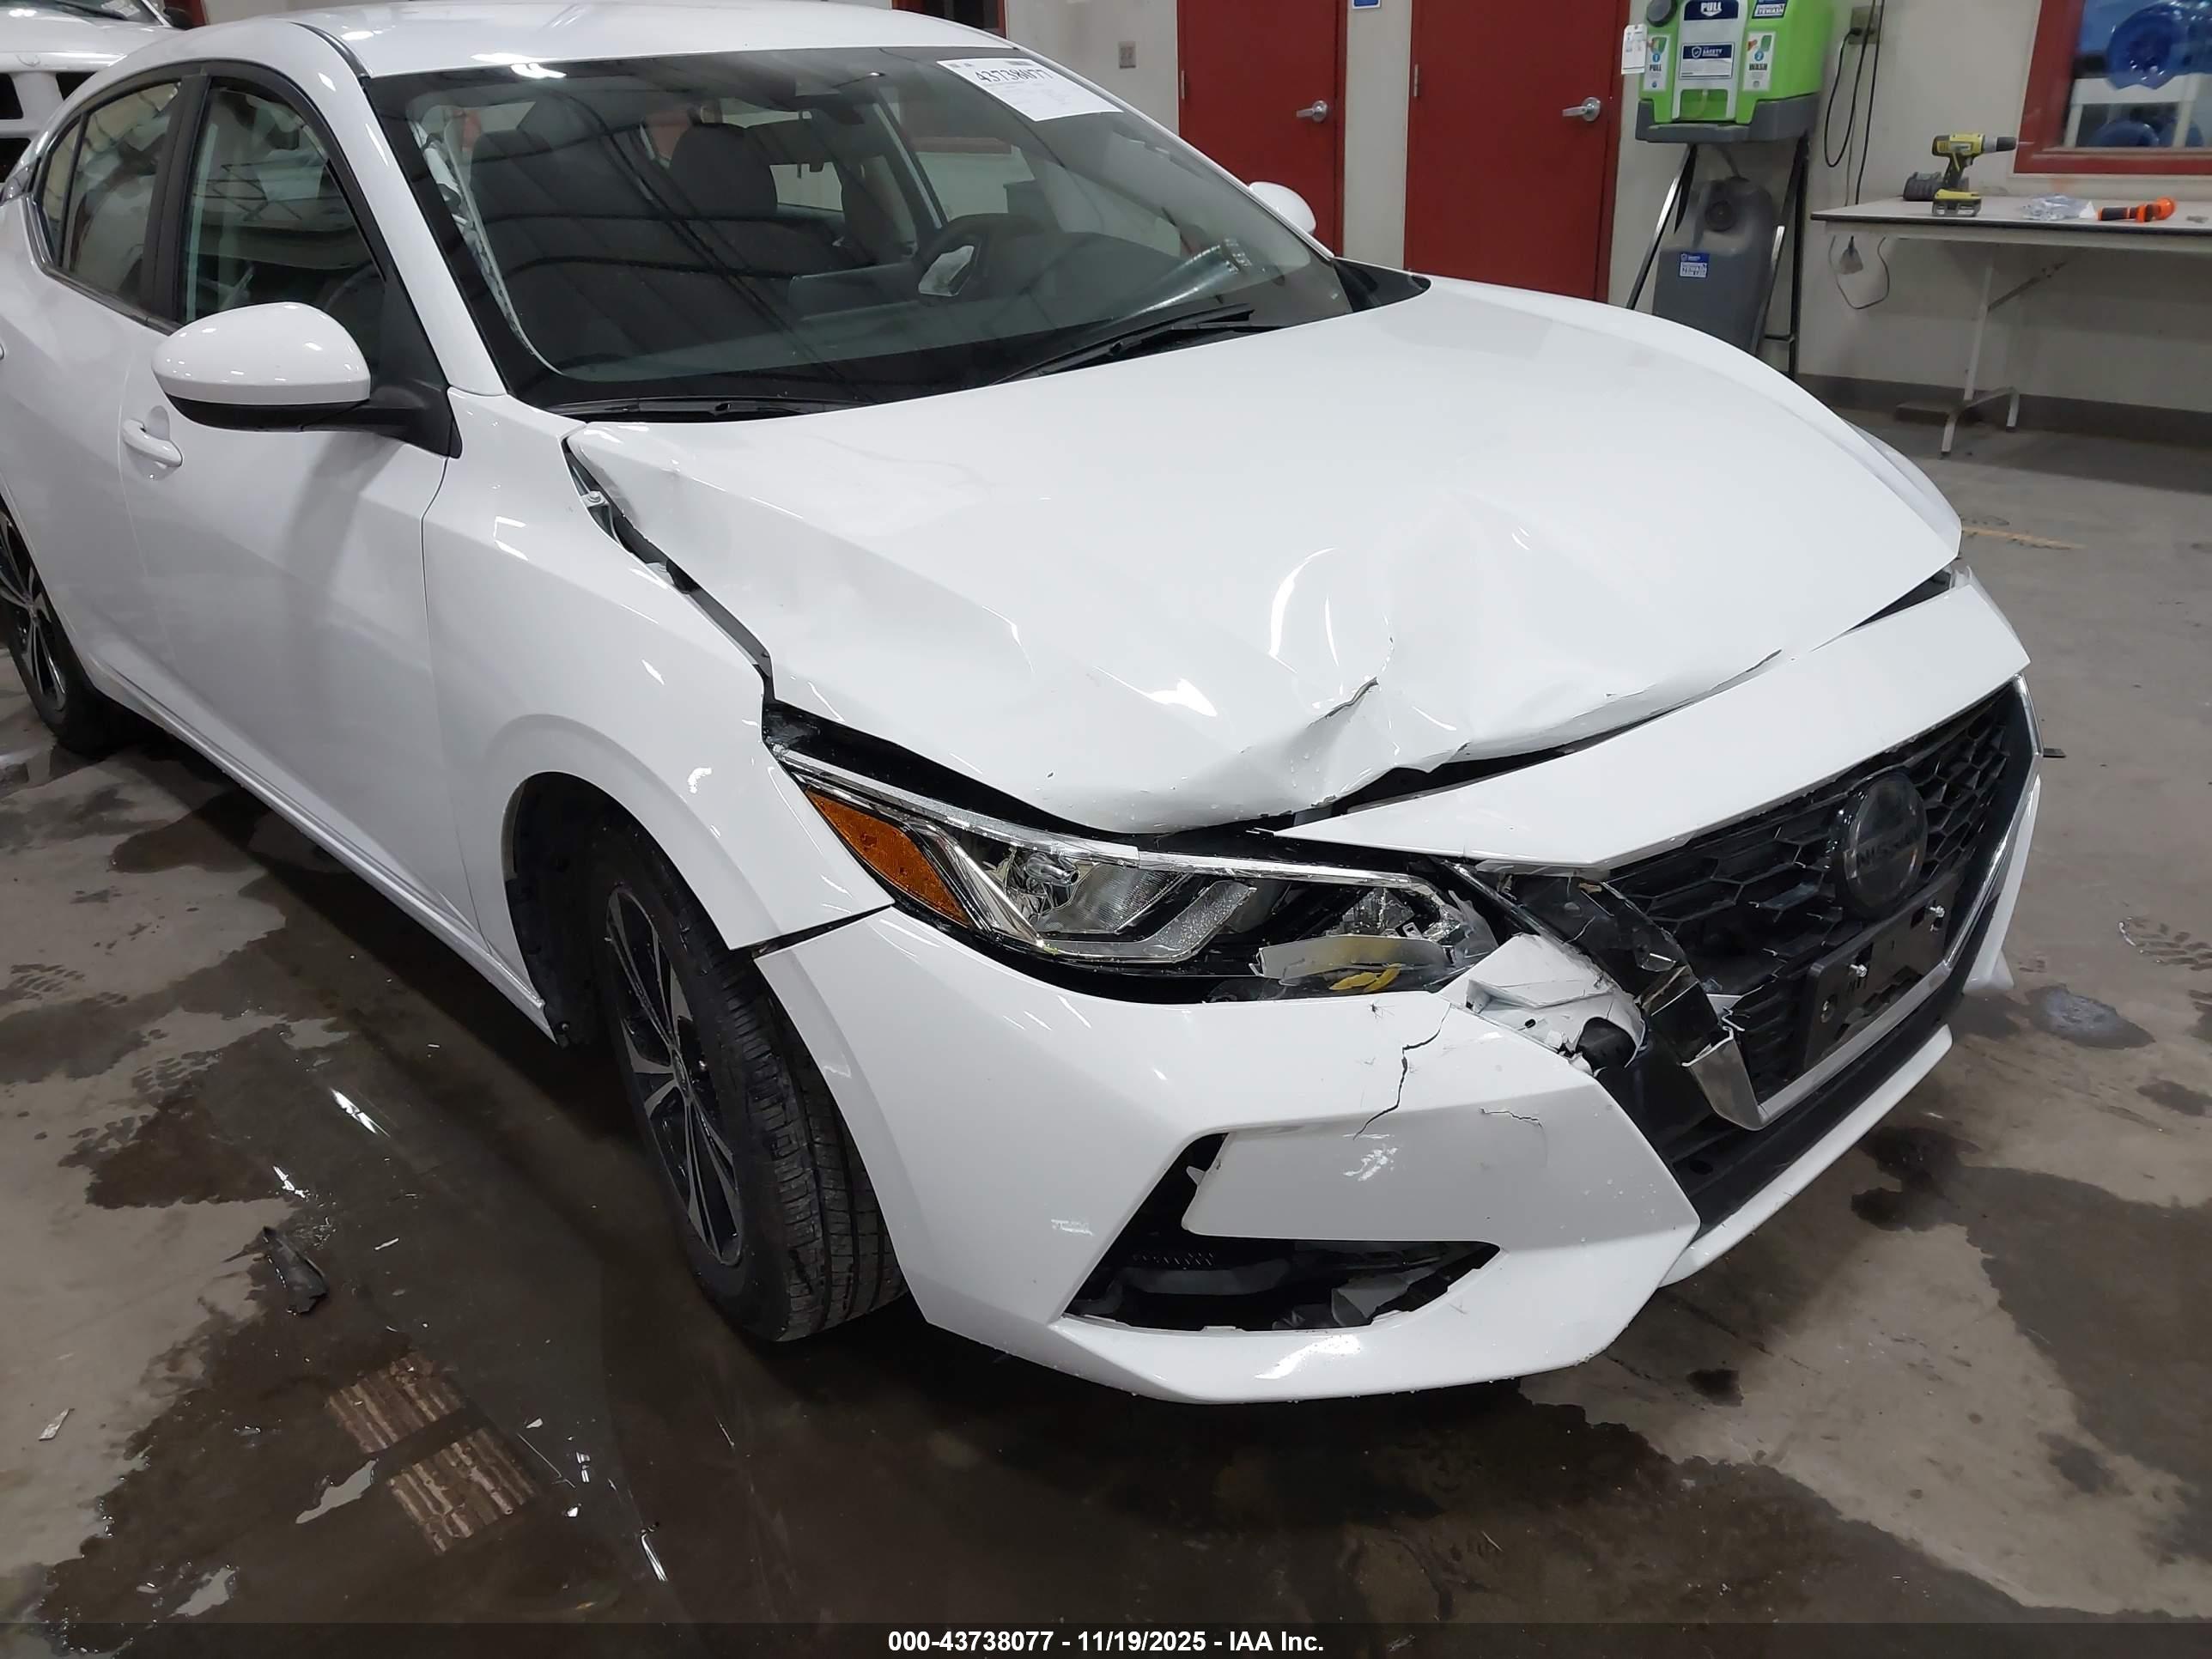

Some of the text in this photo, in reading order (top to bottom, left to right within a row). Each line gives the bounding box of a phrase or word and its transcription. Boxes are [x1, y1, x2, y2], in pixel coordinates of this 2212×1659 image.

[1700, 2, 1723, 14] PULL
[1649, 64, 1662, 72] PULL
[1748, 63, 1768, 71] WASH
